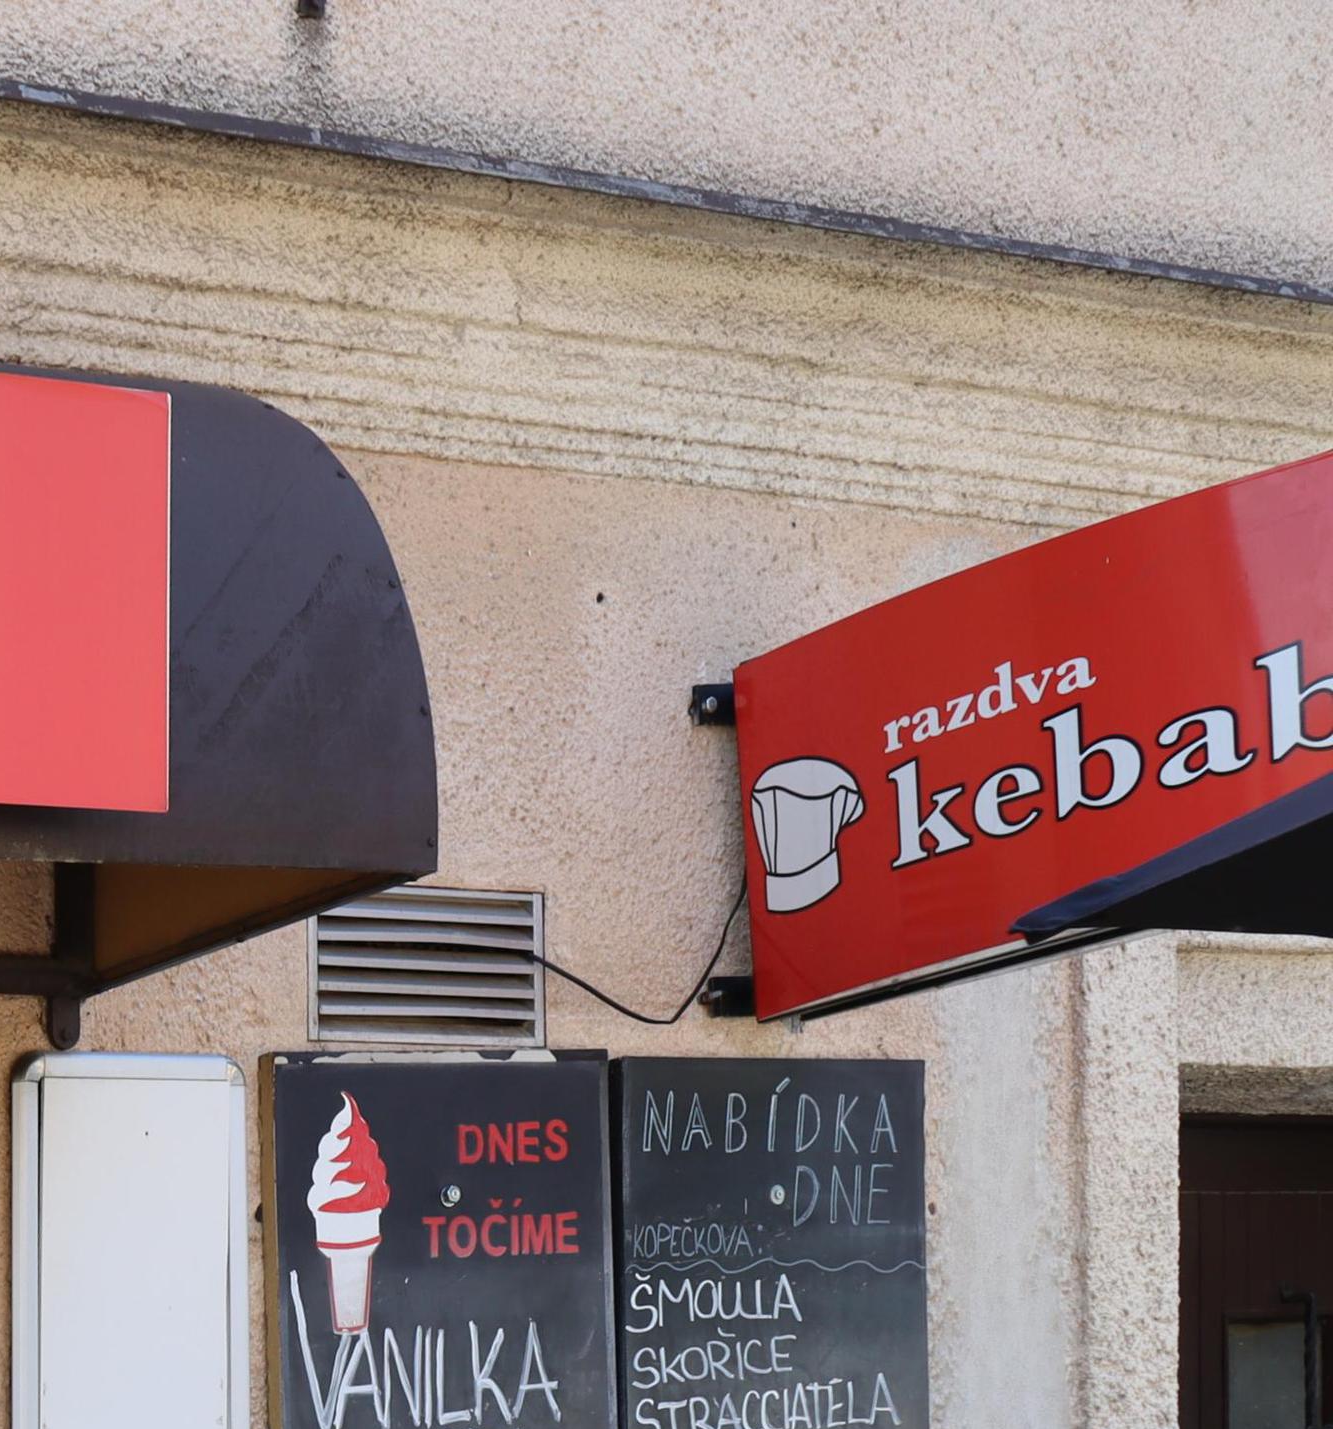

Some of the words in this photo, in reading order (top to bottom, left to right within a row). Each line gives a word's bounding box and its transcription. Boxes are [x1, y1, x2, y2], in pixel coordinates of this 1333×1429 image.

[883, 656, 1097, 754] razdva
[886, 640, 1333, 869] kebab
[457, 1119, 569, 1165] DNES
[642, 1077, 898, 1155] NABÍDKA
[793, 1164, 894, 1226] DNE
[422, 1199, 580, 1258] TOČÍME
[625, 1273, 803, 1333] ŠMOULA
[632, 1327, 797, 1389] SKOŘICE
